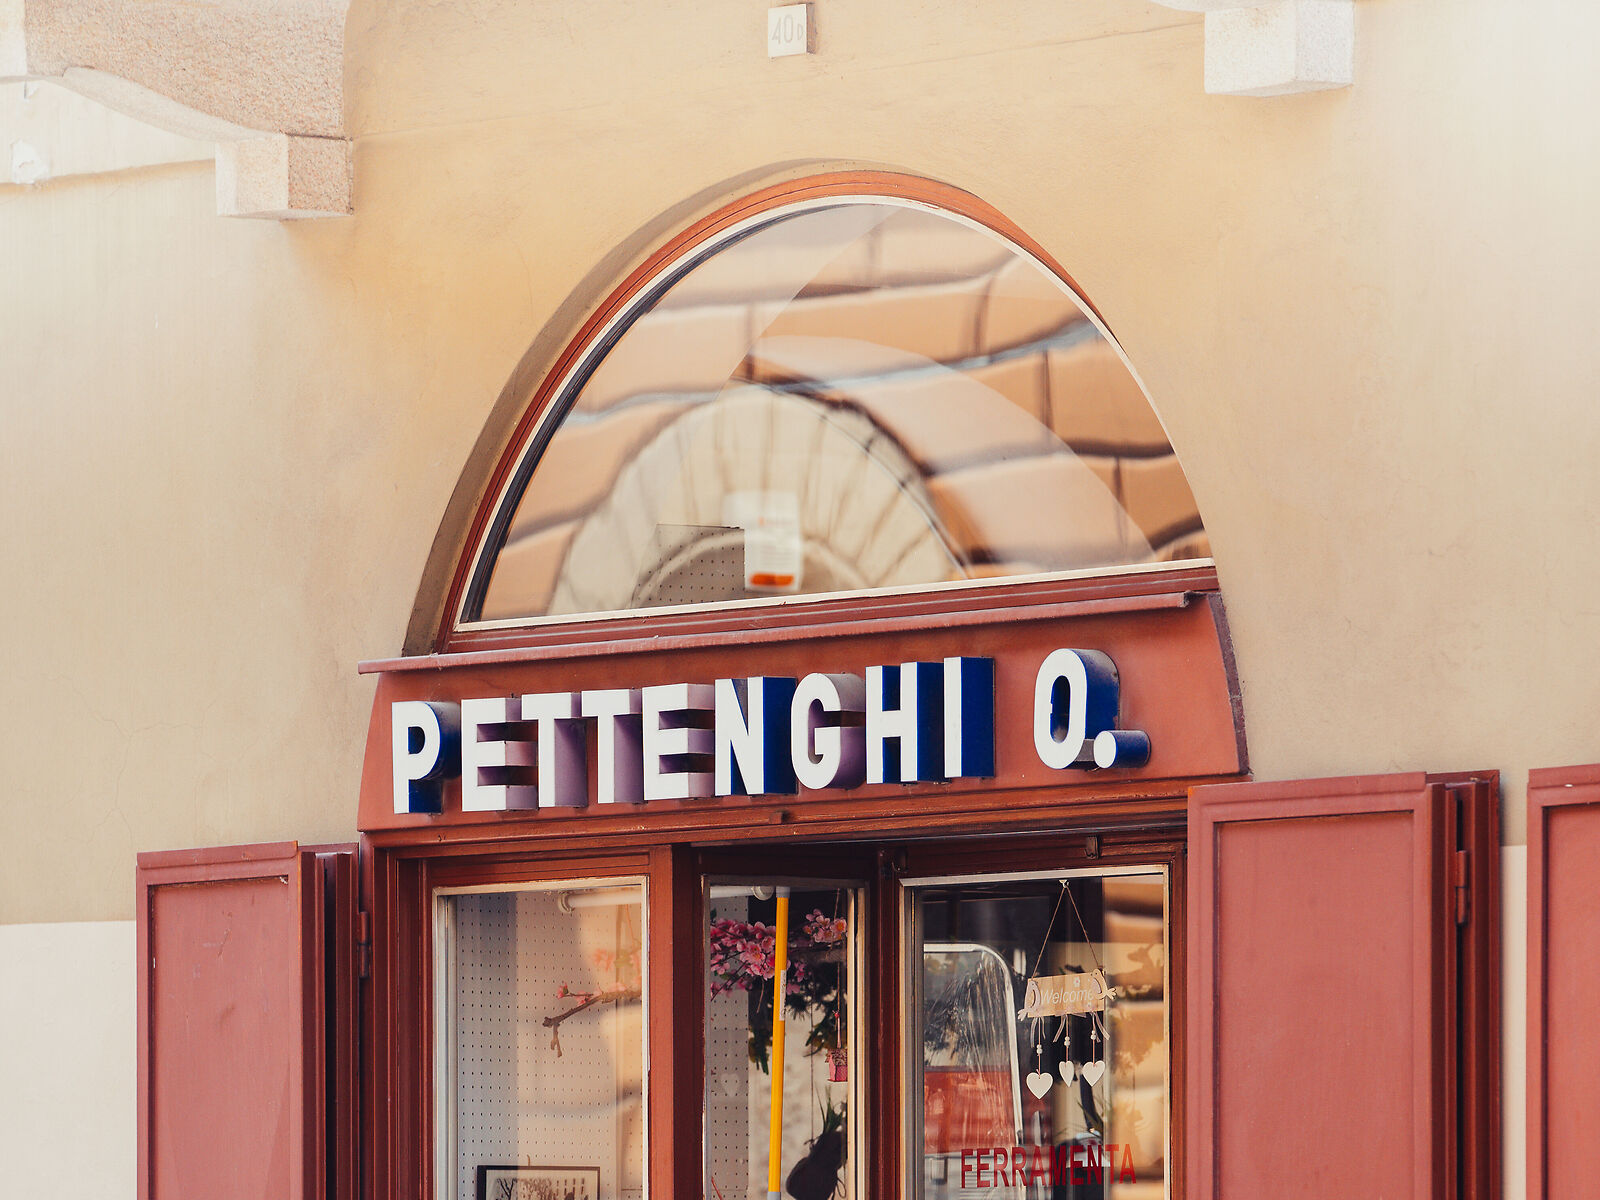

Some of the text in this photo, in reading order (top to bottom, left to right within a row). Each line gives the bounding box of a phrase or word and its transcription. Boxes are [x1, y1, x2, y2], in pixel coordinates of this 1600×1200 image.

[392, 648, 1140, 814] PETTENGHI O.
[961, 1143, 1137, 1189] FERRAMENTA
